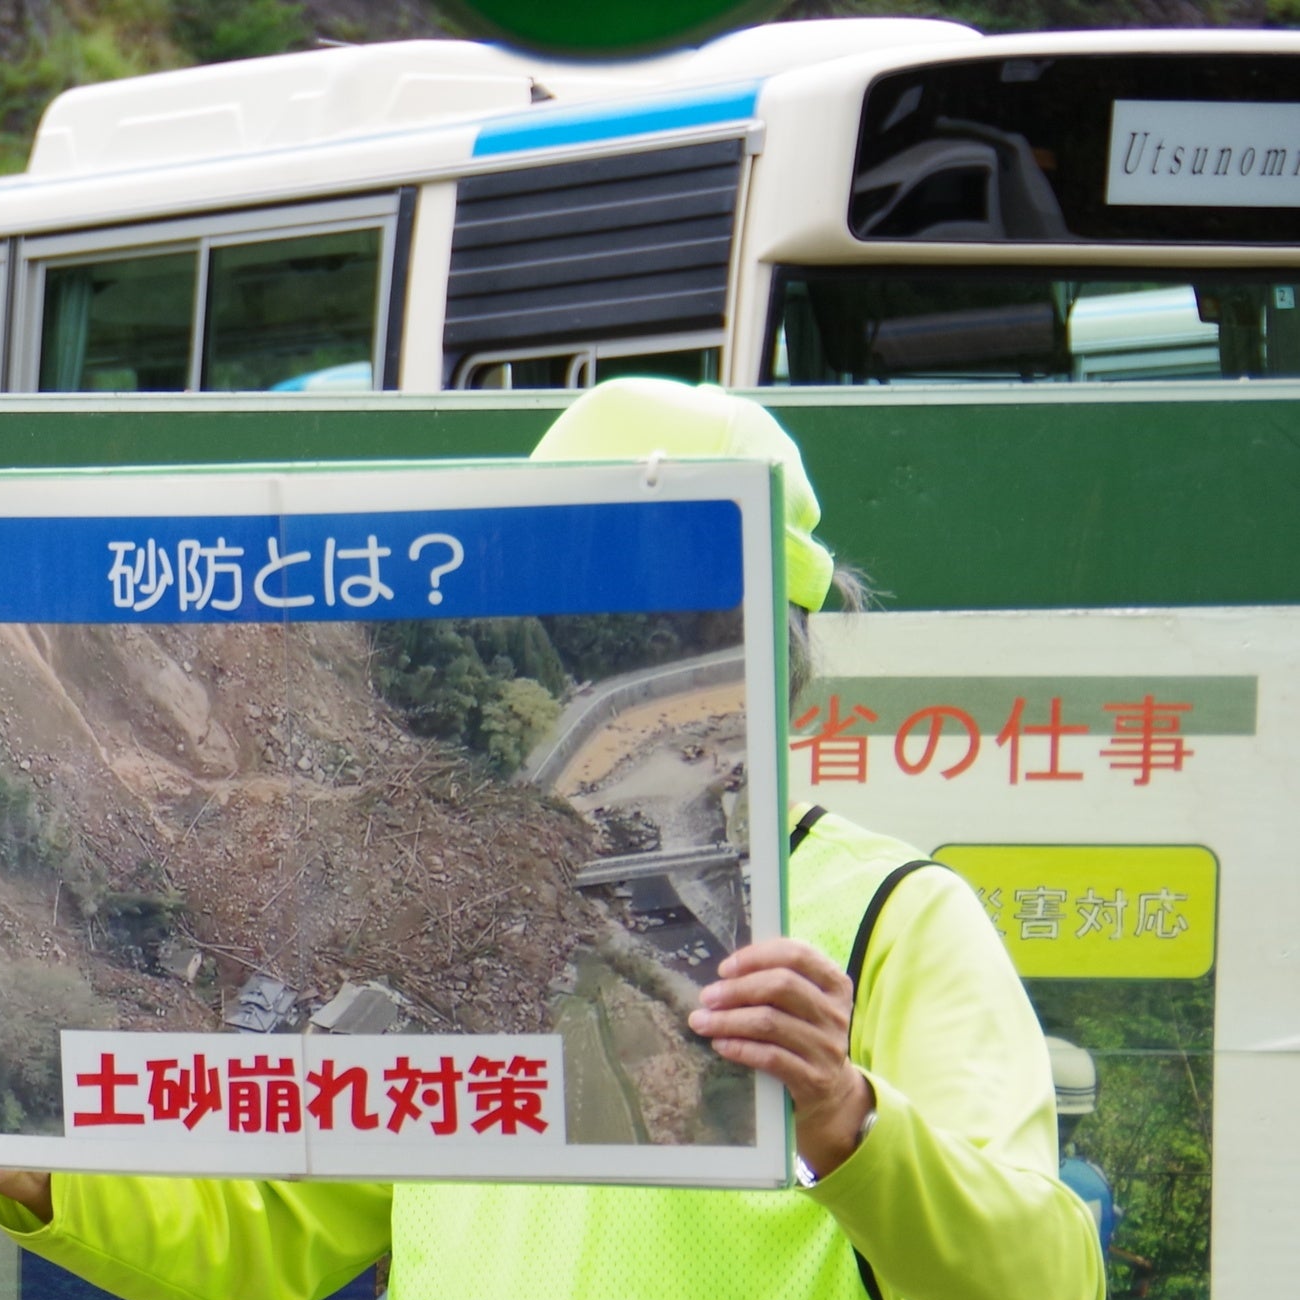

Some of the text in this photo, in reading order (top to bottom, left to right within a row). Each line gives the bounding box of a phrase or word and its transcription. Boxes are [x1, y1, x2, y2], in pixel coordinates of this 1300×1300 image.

[106, 531, 466, 612] 砂防とは？
[788, 694, 1195, 787] 省の仕事
[73, 1052, 551, 1137] 土砂崩れ対策
